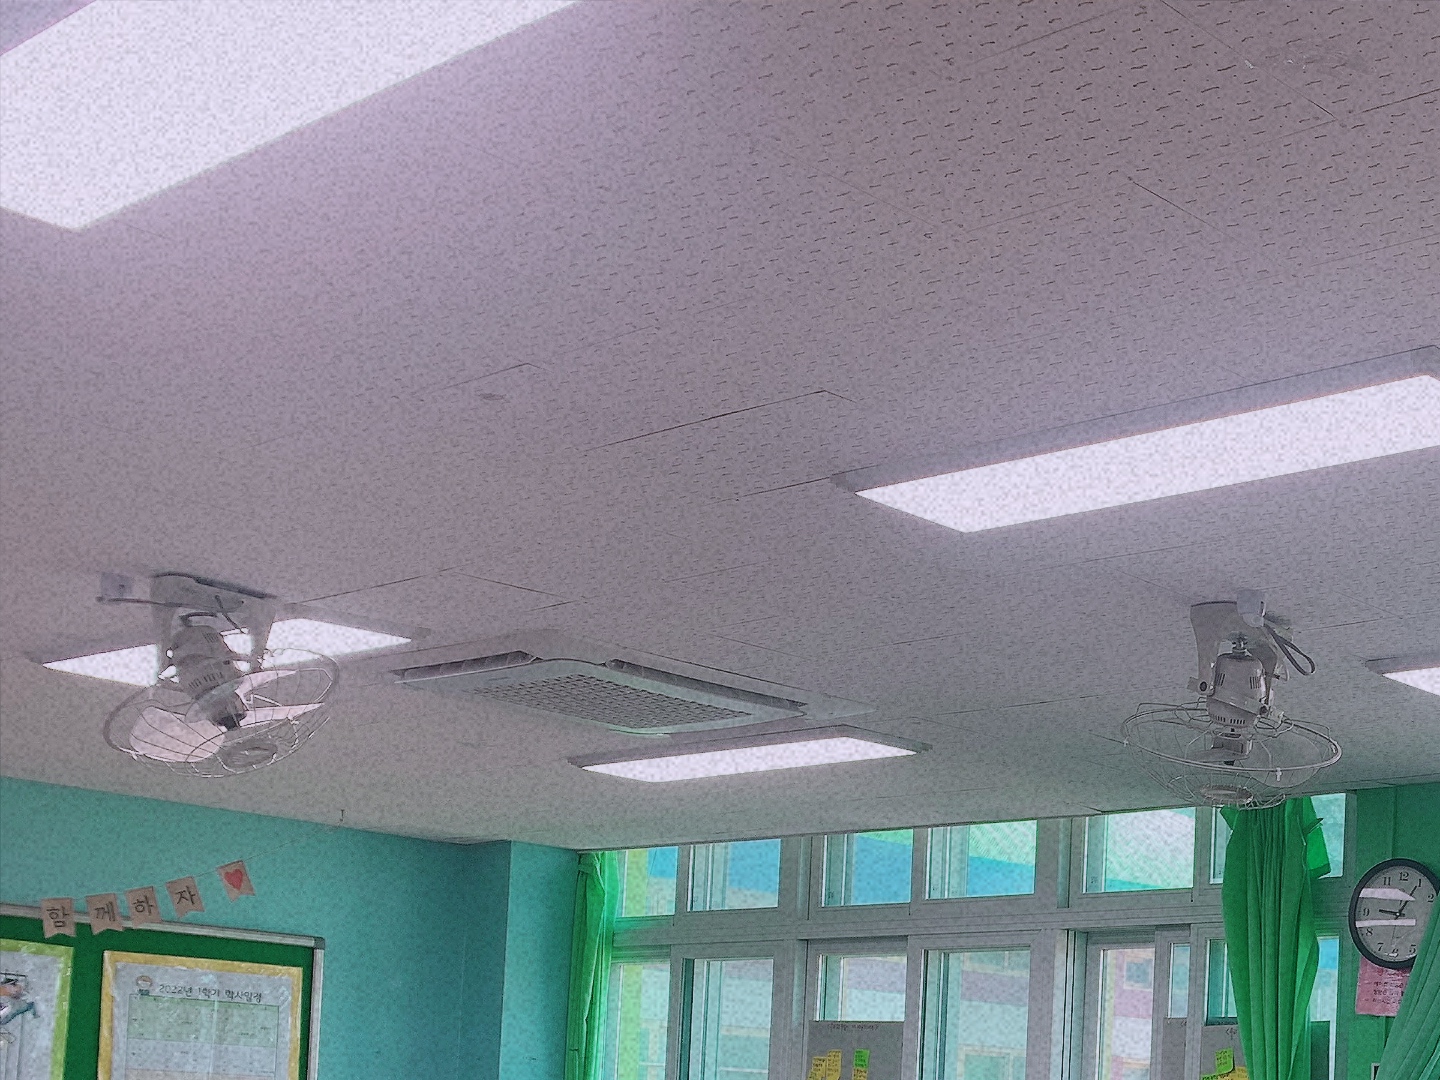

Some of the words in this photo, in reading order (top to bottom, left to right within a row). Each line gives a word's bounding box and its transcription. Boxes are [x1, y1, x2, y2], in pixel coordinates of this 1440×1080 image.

[1383, 876, 1391, 886] 11
[1400, 871, 1409, 881] 12
[1427, 893, 1434, 903] 2
[1363, 907, 1370, 916] 9
[1365, 927, 1374, 937] 8
[1377, 942, 1384, 952] 7
[159, 984, 194, 998] 2022년
[198, 987, 220, 999] 1학기
[224, 990, 262, 1003] 학사일정
